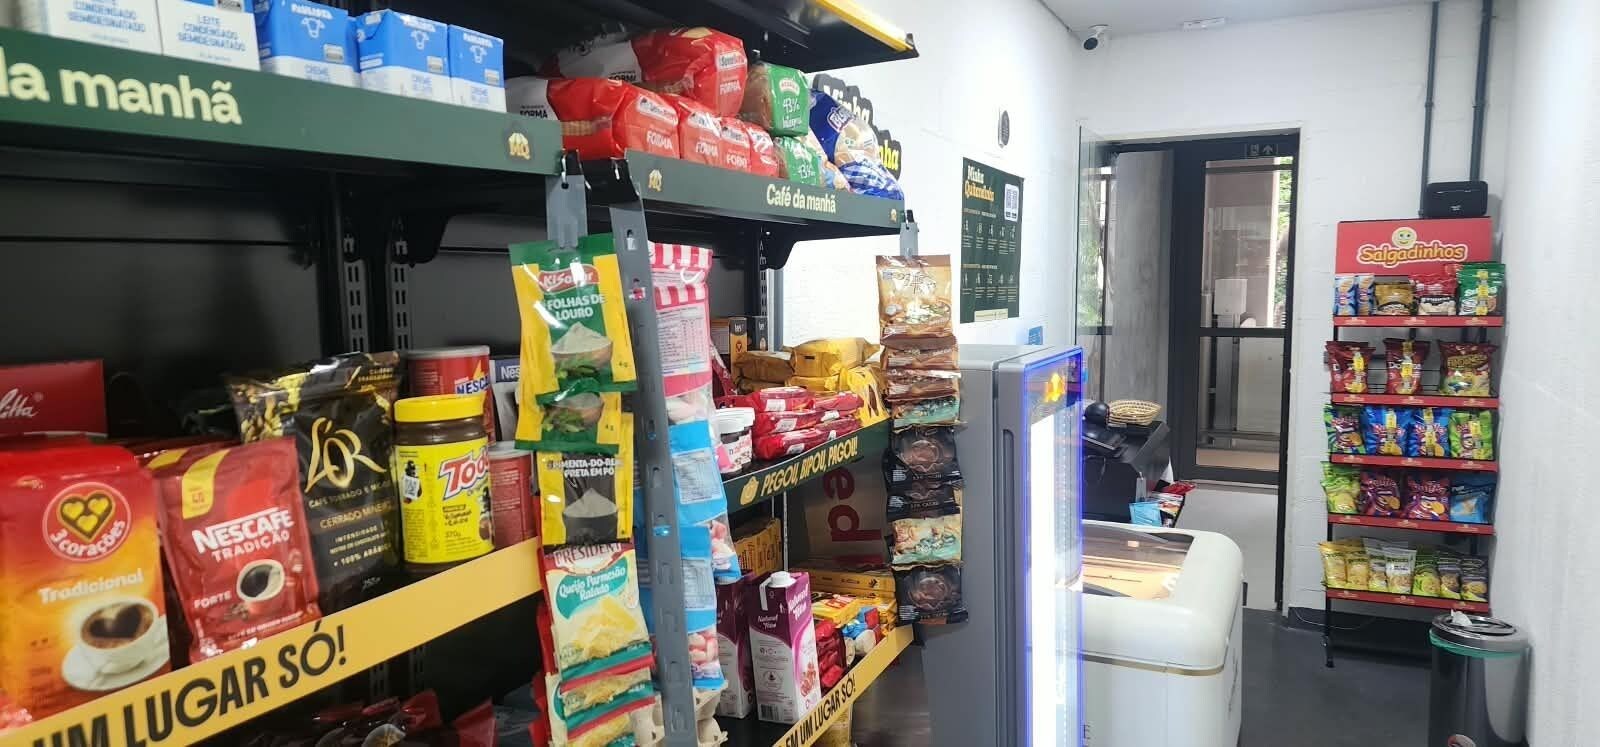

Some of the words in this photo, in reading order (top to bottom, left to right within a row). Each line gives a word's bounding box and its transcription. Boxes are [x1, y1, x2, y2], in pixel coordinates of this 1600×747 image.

[60, 69, 242, 125] manhã
[766, 183, 792, 208] Café
[792, 187, 806, 210] da
[806, 193, 837, 214] manhã
[1358, 242, 1466, 266] Salgadinhos
[547, 295, 591, 311] FOLHAS
[590, 293, 606, 305] DE
[555, 306, 594, 322] LOURO
[0, 388, 37, 419] litta
[563, 467, 590, 479] PRETA
[760, 463, 800, 497] PEGOU,
[828, 435, 859, 467] PAGOU!
[211, 530, 291, 563] TRADIÇÃO
[38, 567, 144, 604] Tradicional
[558, 578, 586, 599] Queijo
[586, 565, 627, 589] Parmesão
[579, 582, 610, 602] Ralado
[193, 590, 233, 609] FORTE
[124, 655, 269, 747] LUGAR
[278, 620, 348, 690] SÓ!
[799, 715, 814, 745] UM
[813, 689, 841, 732] LUGAR
[841, 673, 857, 704] SÓ!
